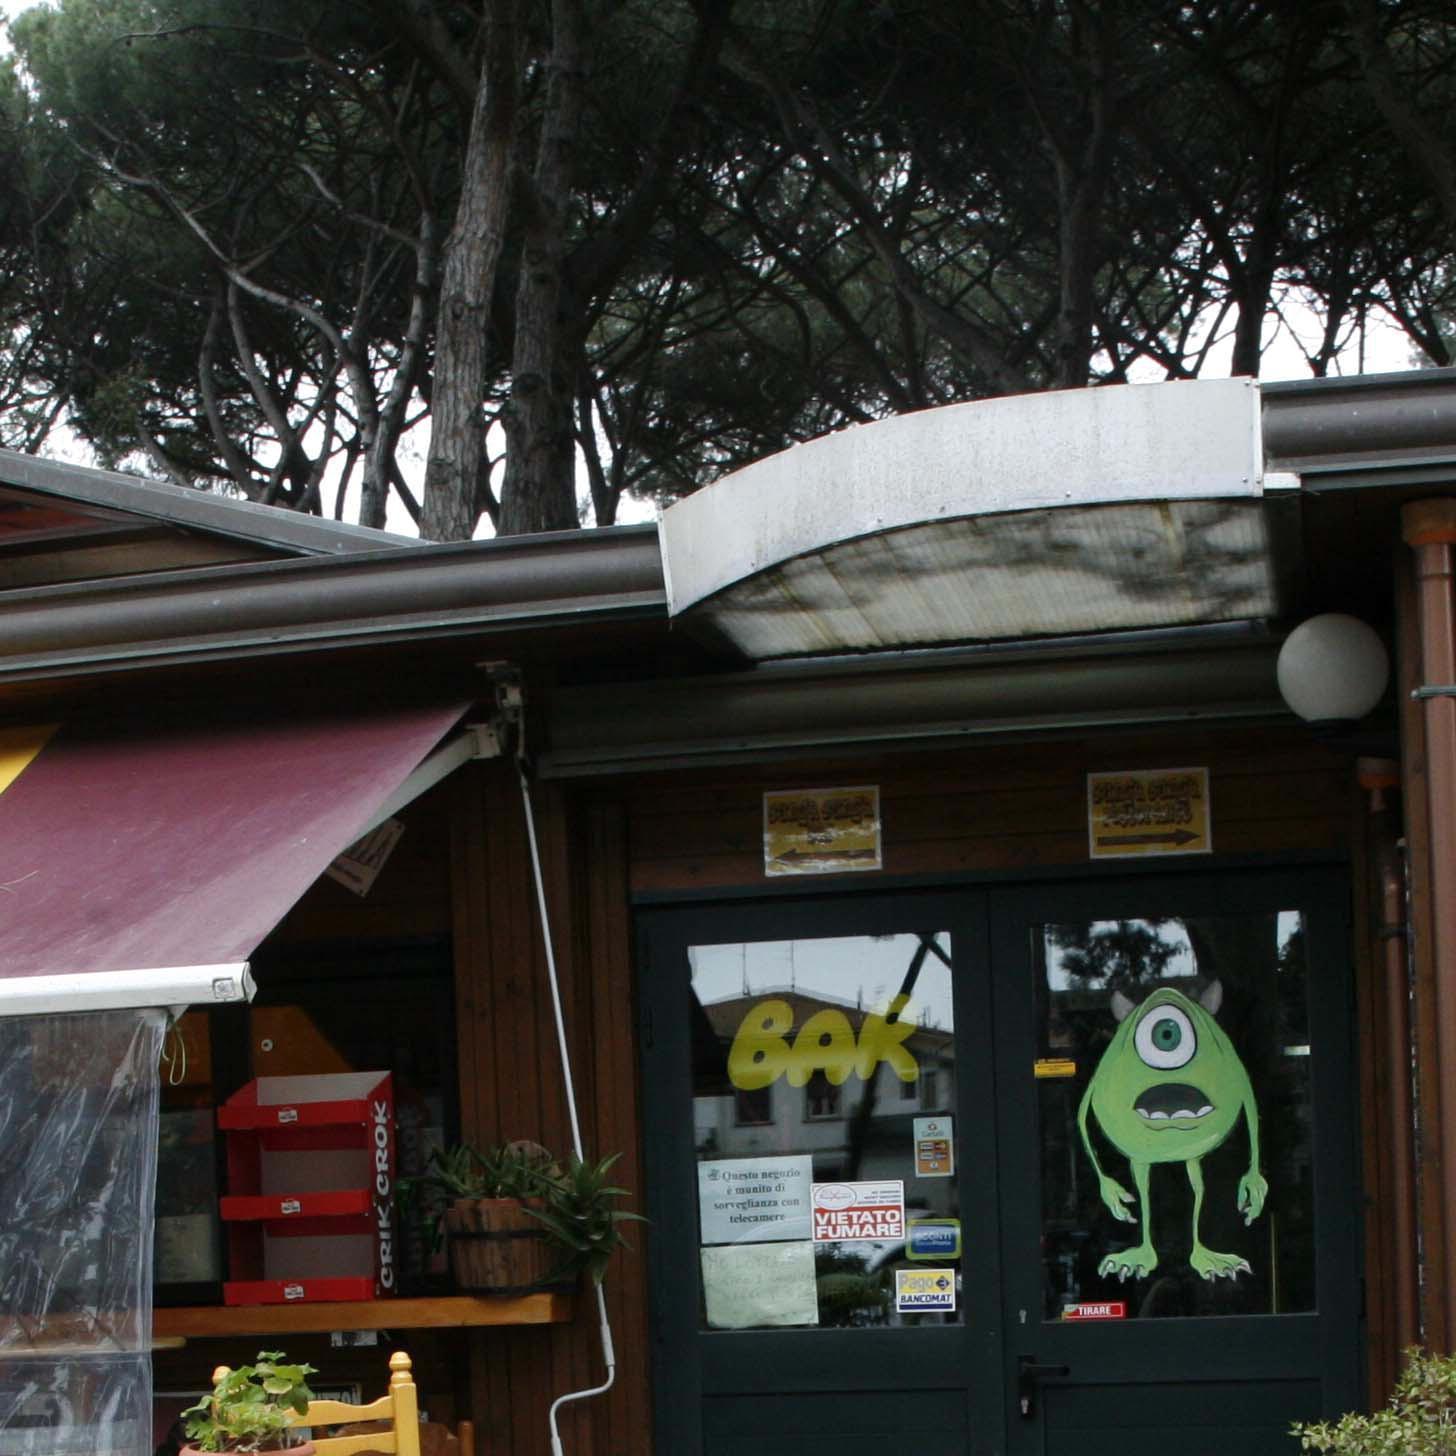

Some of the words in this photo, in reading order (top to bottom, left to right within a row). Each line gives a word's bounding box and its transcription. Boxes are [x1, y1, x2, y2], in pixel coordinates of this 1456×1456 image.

[374, 1100, 390, 1196] CROK
[722, 1170, 758, 1183] Questo
[761, 1168, 801, 1180] negozio
[735, 1184, 772, 1194] munito
[775, 1183, 785, 1192] di
[713, 1199, 779, 1211] sorveglianza
[781, 1199, 800, 1207] con
[729, 1213, 785, 1224] telecamere
[815, 1210, 901, 1225] VIETATO
[816, 1223, 901, 1239] FUMARE
[377, 1205, 393, 1289] CRIK
[899, 1274, 933, 1292] Pago
[900, 1294, 952, 1304] BANCOMAT
[1078, 1305, 1111, 1316] TIRARE
